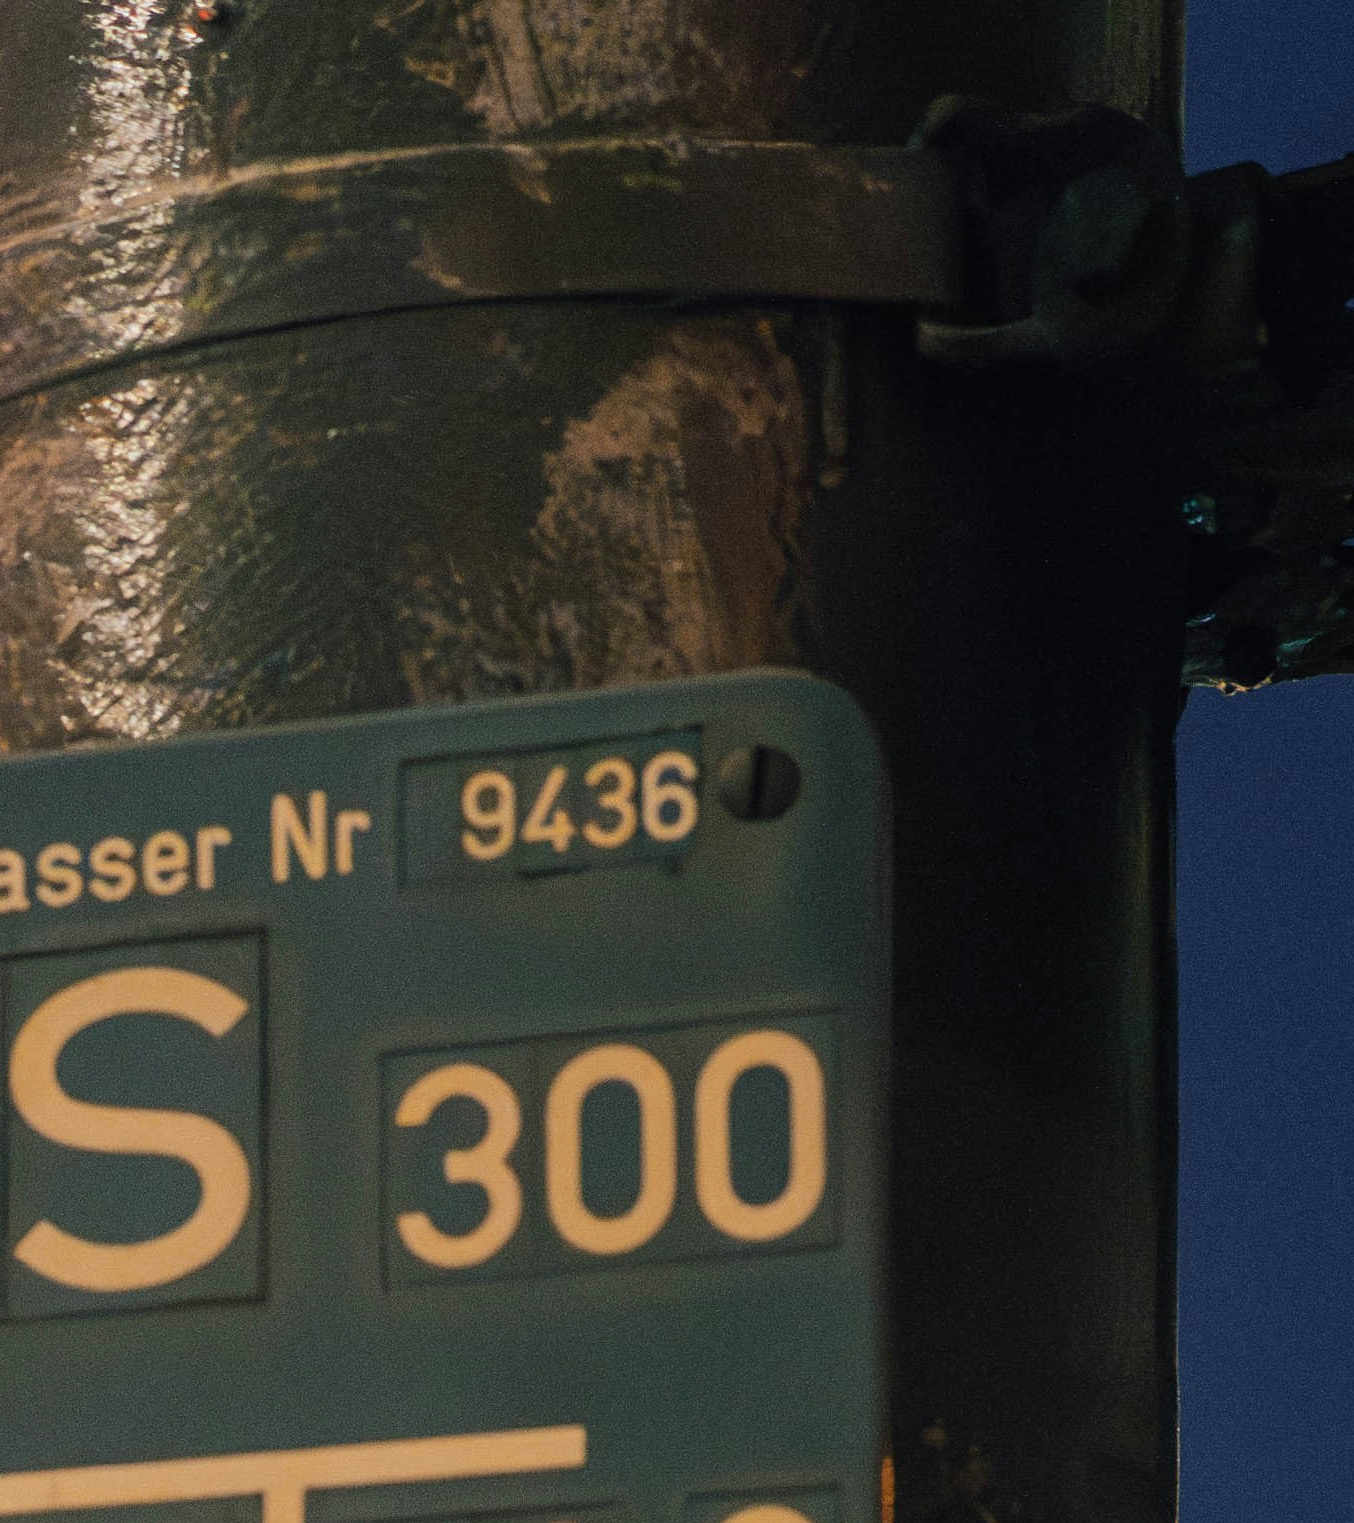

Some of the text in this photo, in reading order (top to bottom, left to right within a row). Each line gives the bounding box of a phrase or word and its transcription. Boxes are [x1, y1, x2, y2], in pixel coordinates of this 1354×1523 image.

[270, 792, 370, 883] Nr
[461, 752, 701, 860] 9436
[9, 967, 827, 1292] S 300
